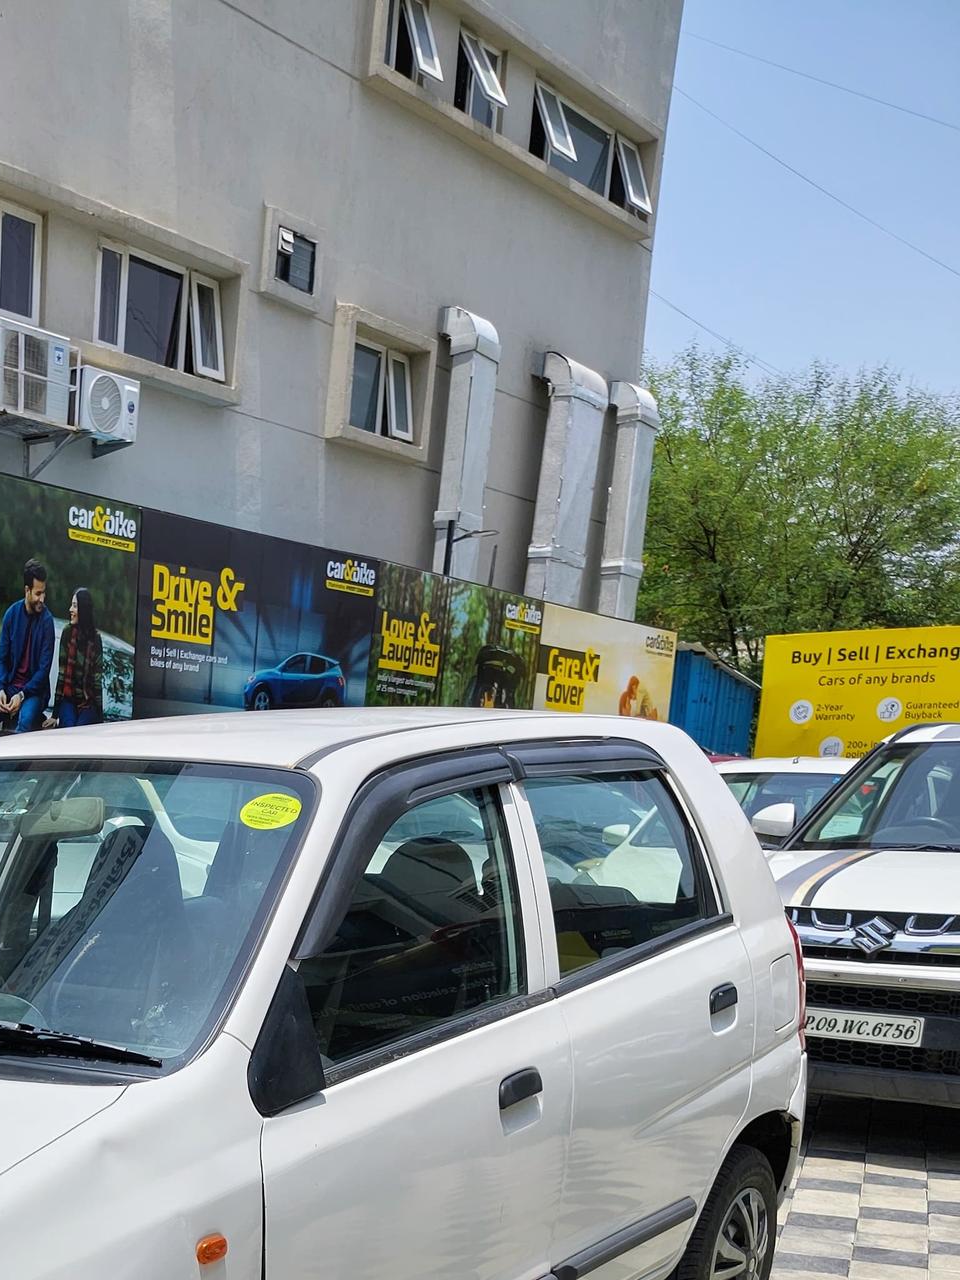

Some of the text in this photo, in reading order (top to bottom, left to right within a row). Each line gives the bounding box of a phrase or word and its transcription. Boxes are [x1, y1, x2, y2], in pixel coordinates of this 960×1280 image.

[68, 505, 137, 539] car&bike
[326, 559, 376, 586] car&bike
[152, 564, 245, 612] Drive &
[151, 598, 211, 638] Smile
[505, 602, 542, 625] car&bike
[381, 611, 437, 644] Love &
[150, 646, 163, 658] Buy
[166, 648, 177, 658] Sell
[180, 650, 206, 663] Exchange
[205, 655, 217, 663] cars
[217, 656, 228, 665] and
[380, 635, 438, 670] Laughter
[791, 651, 822, 666] Buy
[837, 646, 870, 662] Sell
[885, 643, 960, 661] Exchang
[150, 657, 200, 672] bikes of any brand
[548, 647, 601, 683] Care &
[545, 676, 584, 706] Cover
[818, 672, 936, 687] Cars of any brands
[815, 710, 943, 722] Warranty Buyback
[816, 700, 960, 712] 2-Year Guaranteed
[846, 740, 868, 749] 200+
[250, 801, 298, 814] INSPECTED
